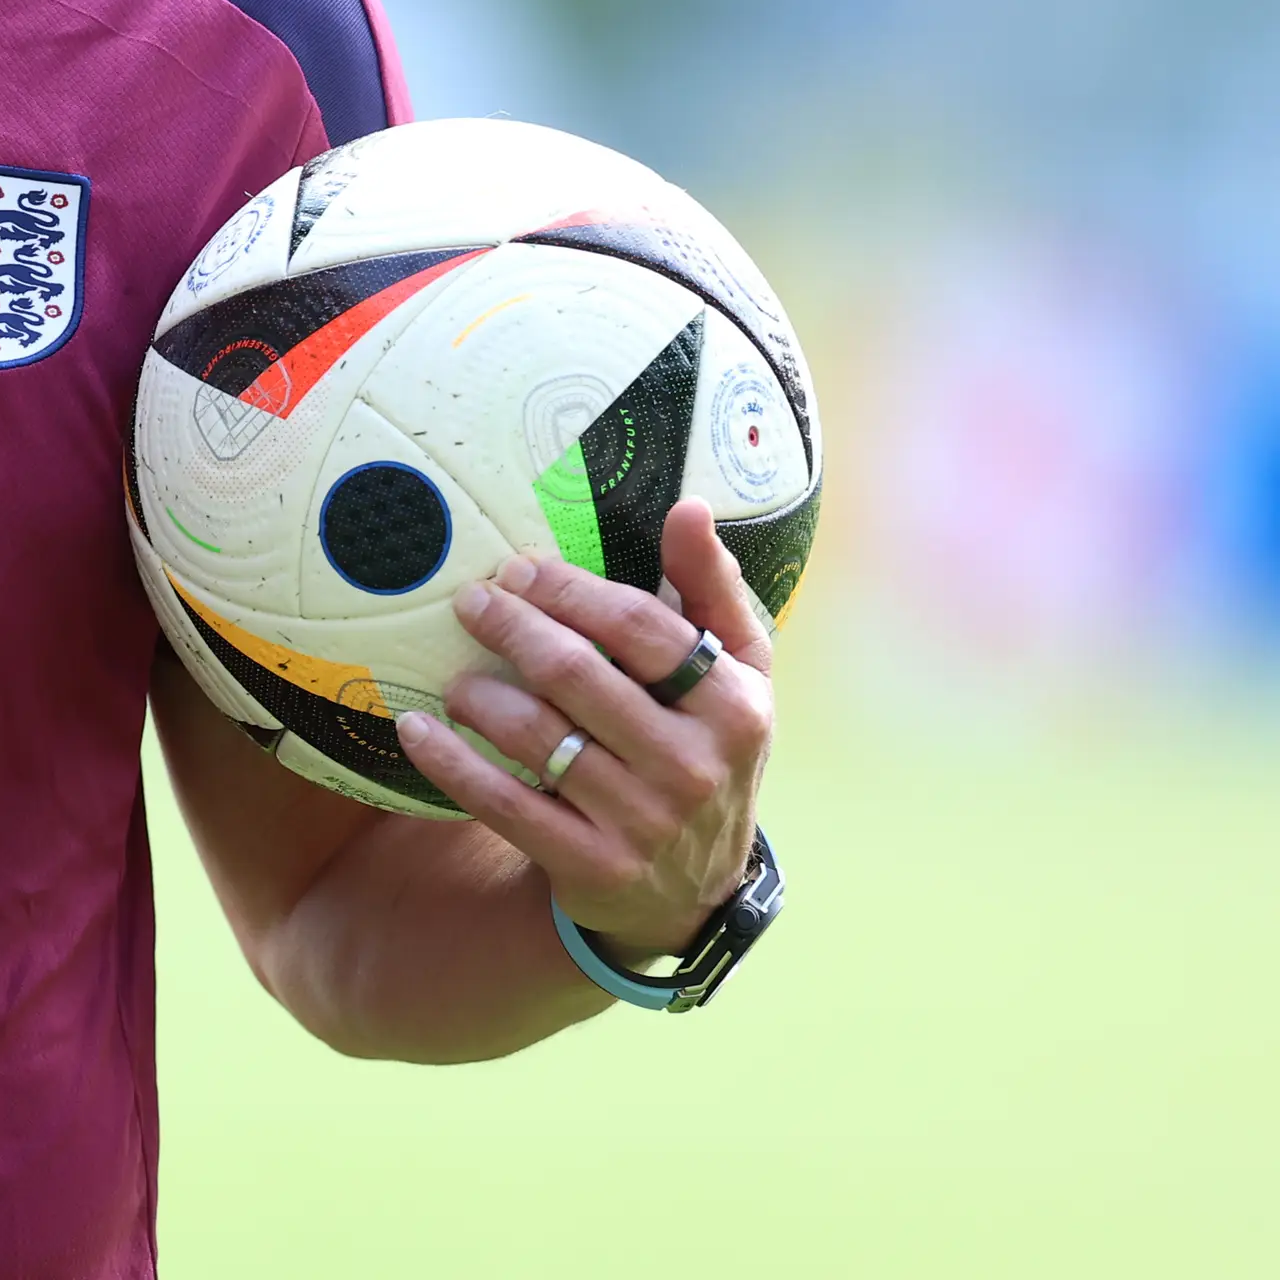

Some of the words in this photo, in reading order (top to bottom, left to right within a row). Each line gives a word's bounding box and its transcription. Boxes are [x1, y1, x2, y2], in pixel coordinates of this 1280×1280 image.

[202, 339, 279, 381] GELSENKIRCHEN
[600, 408, 636, 495] FRANKFURT
[336, 715, 399, 758] HAMBURG
